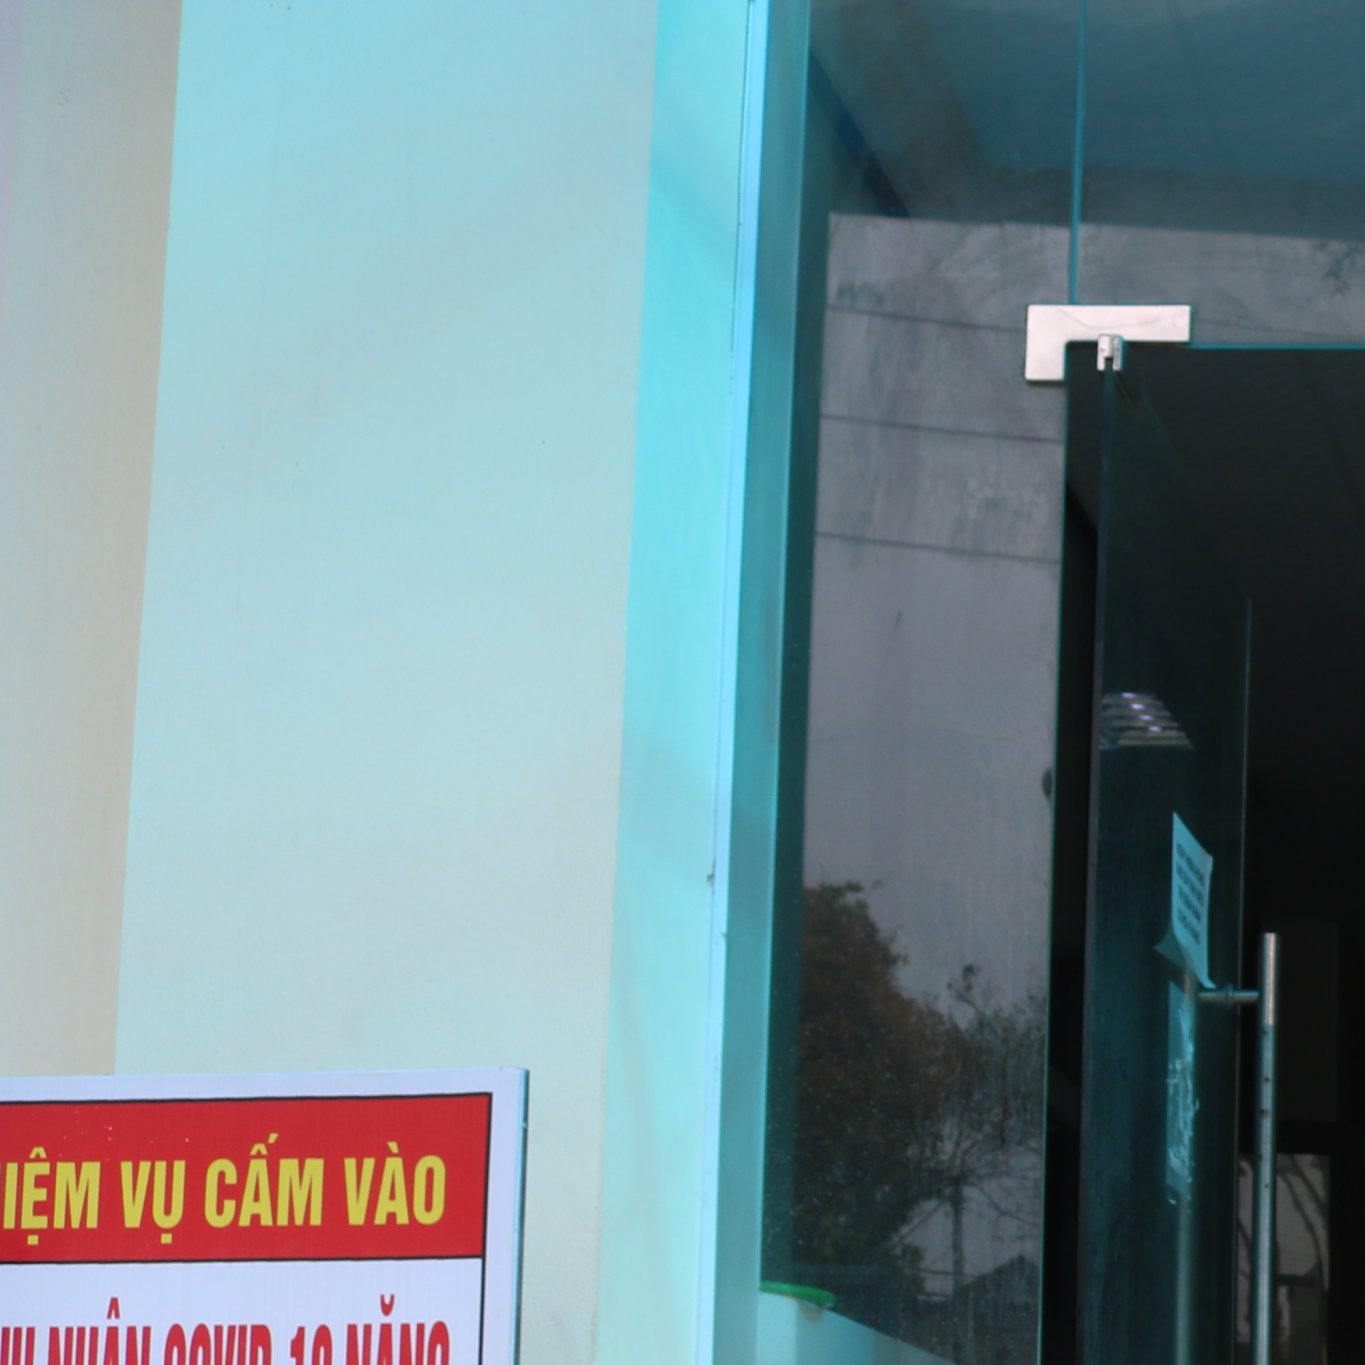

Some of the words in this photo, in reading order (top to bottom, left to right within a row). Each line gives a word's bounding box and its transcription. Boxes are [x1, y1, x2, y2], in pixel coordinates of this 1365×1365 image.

[121, 1160, 186, 1244] VỤ
[205, 1134, 325, 1228] CẤM
[345, 1142, 446, 1226] VÀO
